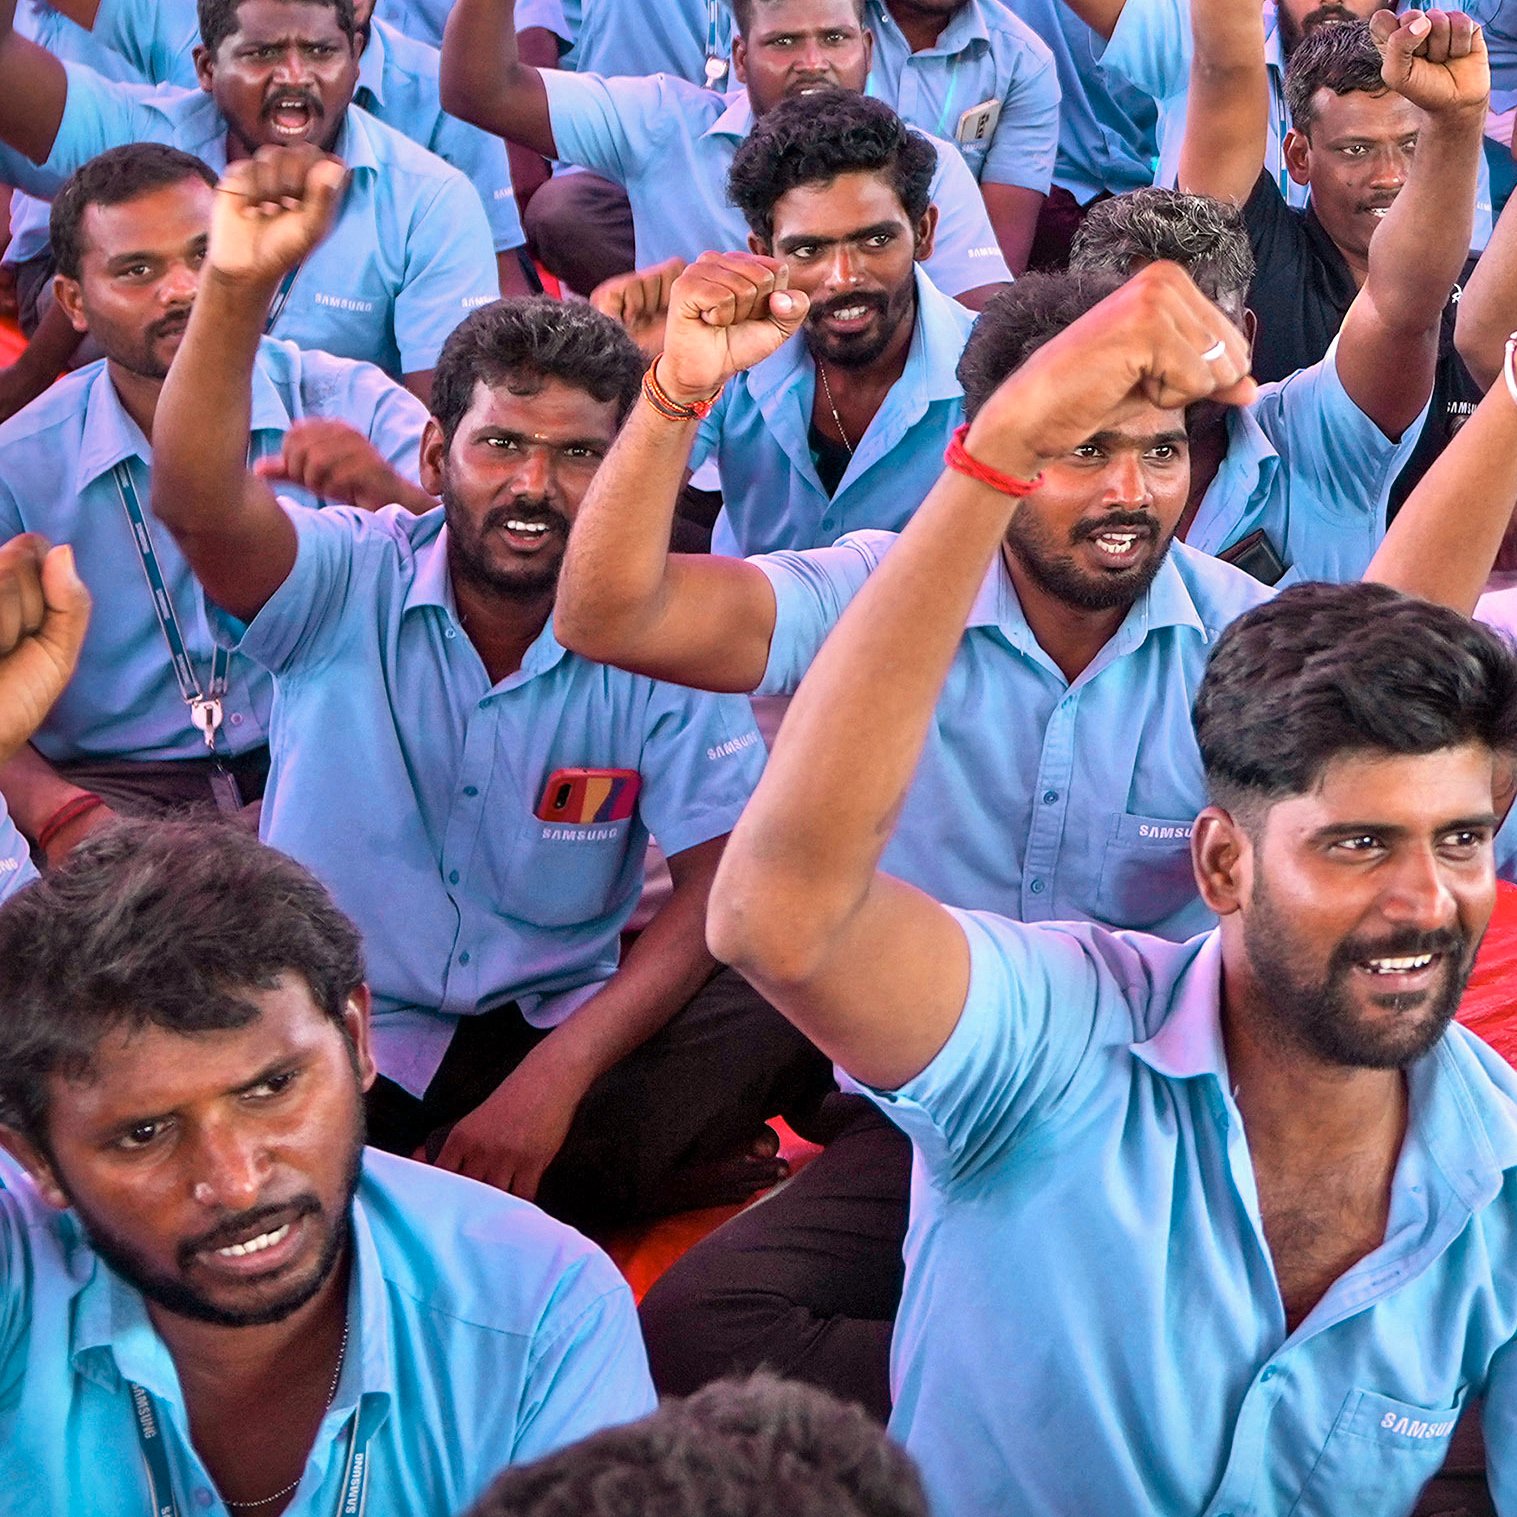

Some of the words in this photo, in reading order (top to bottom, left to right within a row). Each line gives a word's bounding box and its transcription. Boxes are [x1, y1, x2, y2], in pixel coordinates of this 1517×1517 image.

[314, 292, 373, 314] SAMSUNG
[542, 828, 618, 843] SAMSUNG
[1139, 824, 1192, 839] SAMSU
[345, 1452, 364, 1515] SAMSUNG
